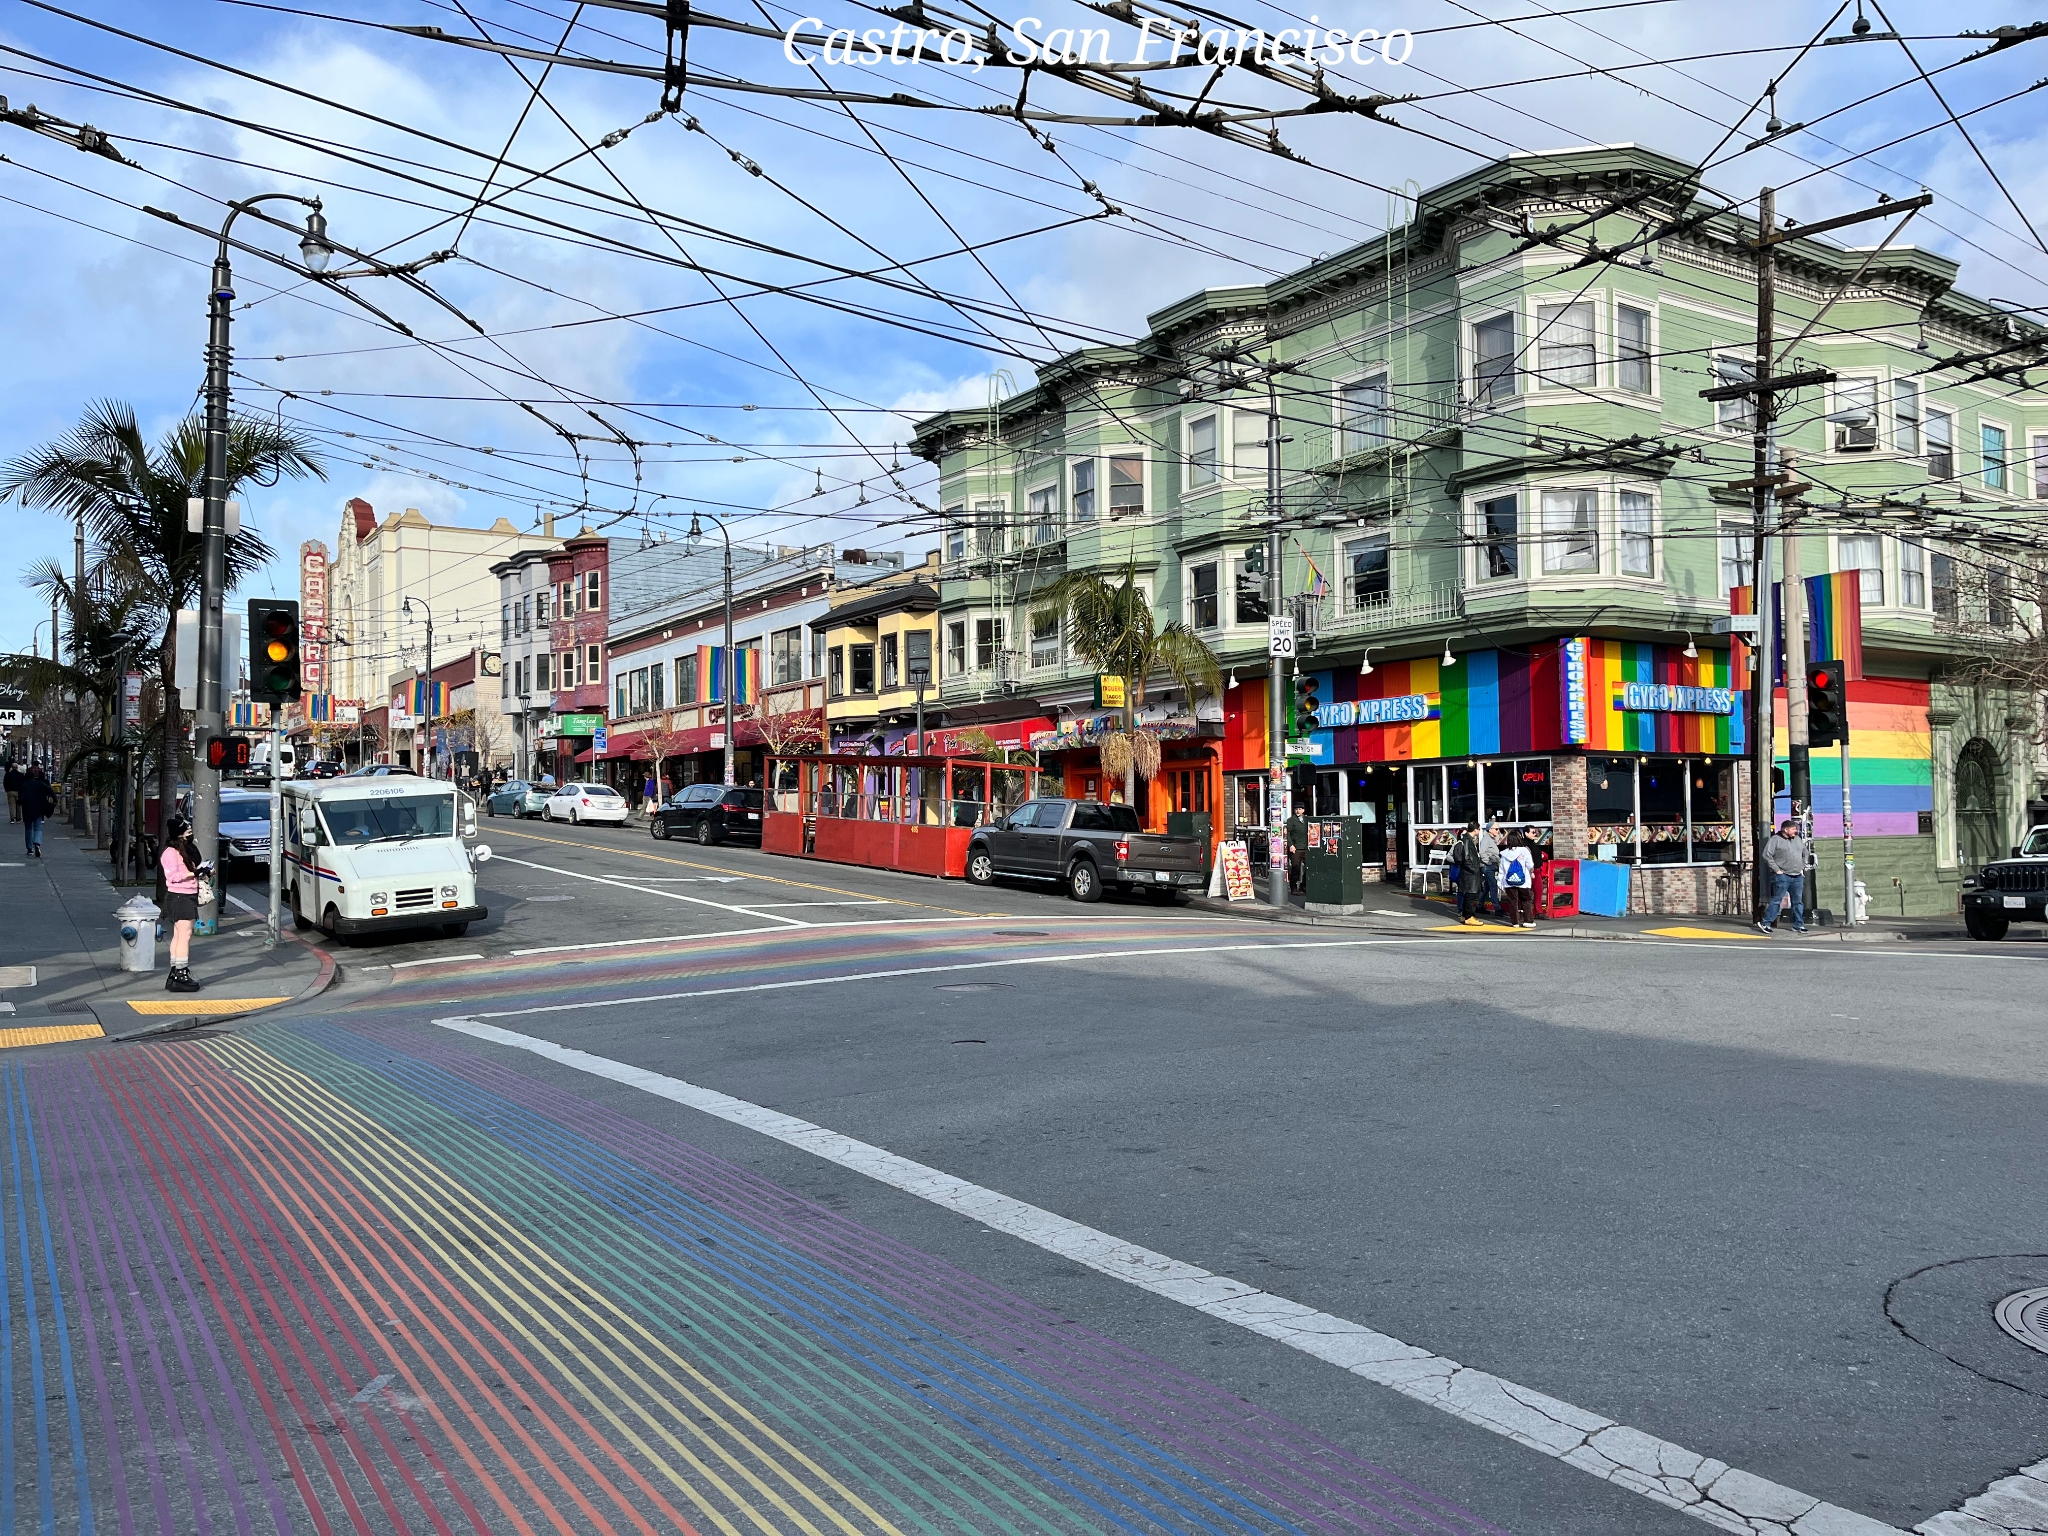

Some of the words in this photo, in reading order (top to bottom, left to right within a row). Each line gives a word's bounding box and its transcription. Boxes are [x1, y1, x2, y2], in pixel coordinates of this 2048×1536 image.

[306, 554, 324, 681] CASTRO
[1271, 620, 1292, 628] SPEED
[1273, 628, 1290, 636] LIMIT
[1272, 637, 1292, 653] 20
[1628, 683, 1670, 710] GYRO
[1675, 686, 1732, 713] XPRESS
[1312, 701, 1354, 727] YRO
[1358, 694, 1427, 724] XPRESS
[1522, 772, 1545, 782] OPEN
